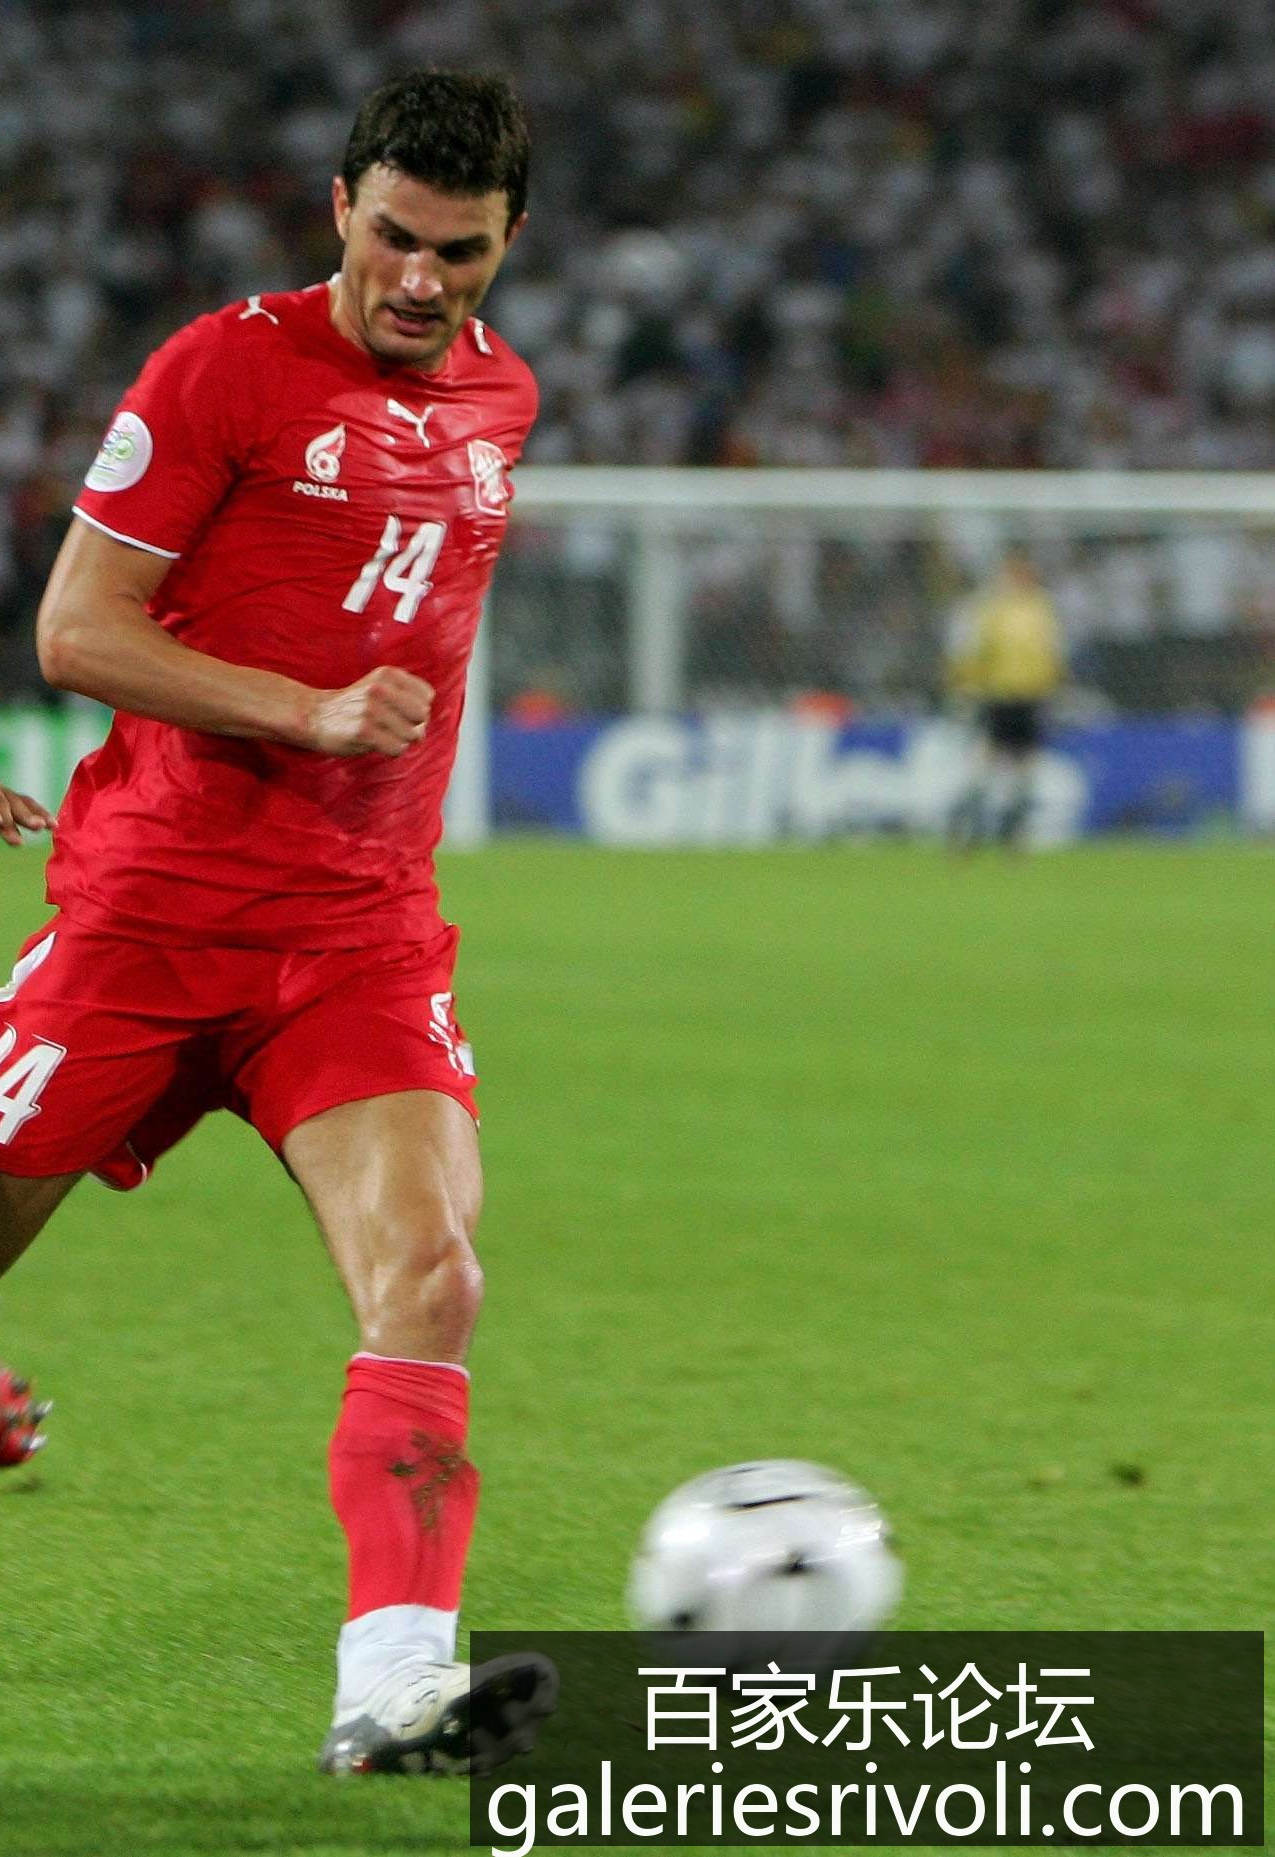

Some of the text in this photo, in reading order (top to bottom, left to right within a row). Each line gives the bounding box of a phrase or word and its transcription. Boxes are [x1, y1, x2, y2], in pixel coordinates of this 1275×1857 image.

[292, 480, 349, 502] POLSKA
[341, 513, 447, 624] 14
[579, 712, 1087, 847] Gillete
